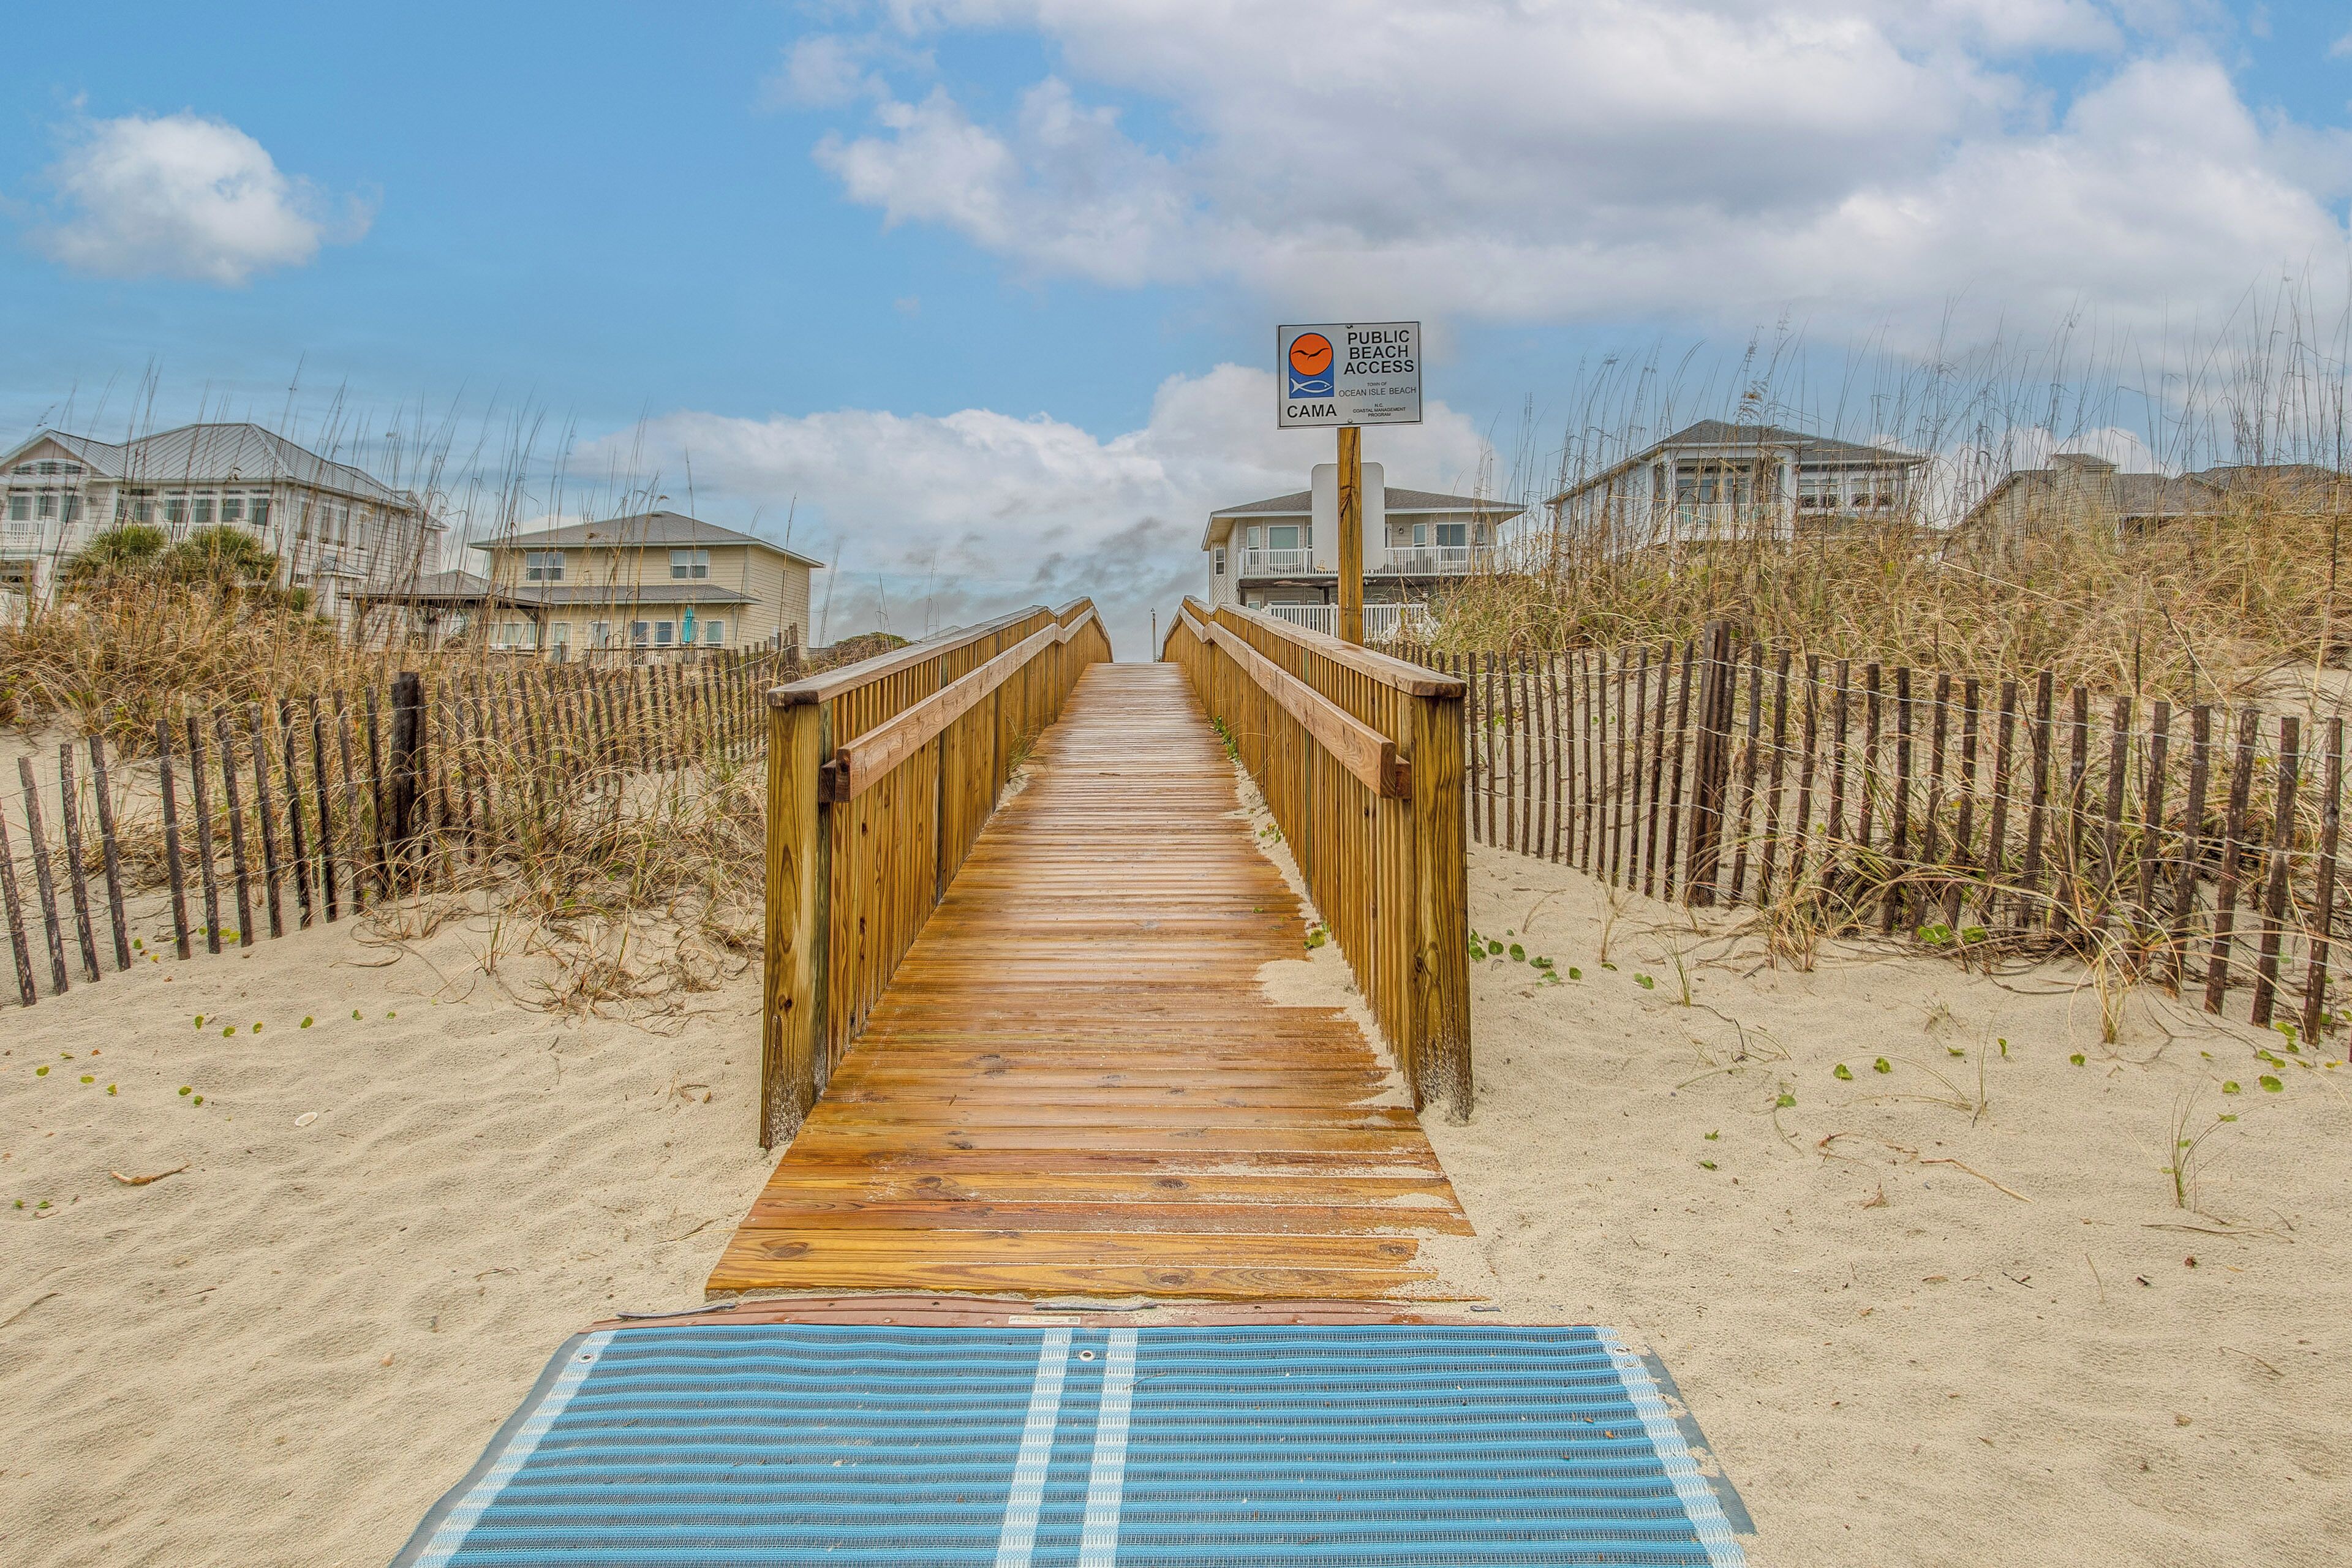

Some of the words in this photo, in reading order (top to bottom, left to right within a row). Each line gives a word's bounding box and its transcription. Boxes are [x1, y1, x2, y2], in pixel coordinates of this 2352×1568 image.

[1348, 330, 1410, 345] PUBLIC
[1349, 345, 1409, 360] BEACH
[1344, 360, 1414, 375] ACCESS
[1287, 404, 1337, 418] CAMA
